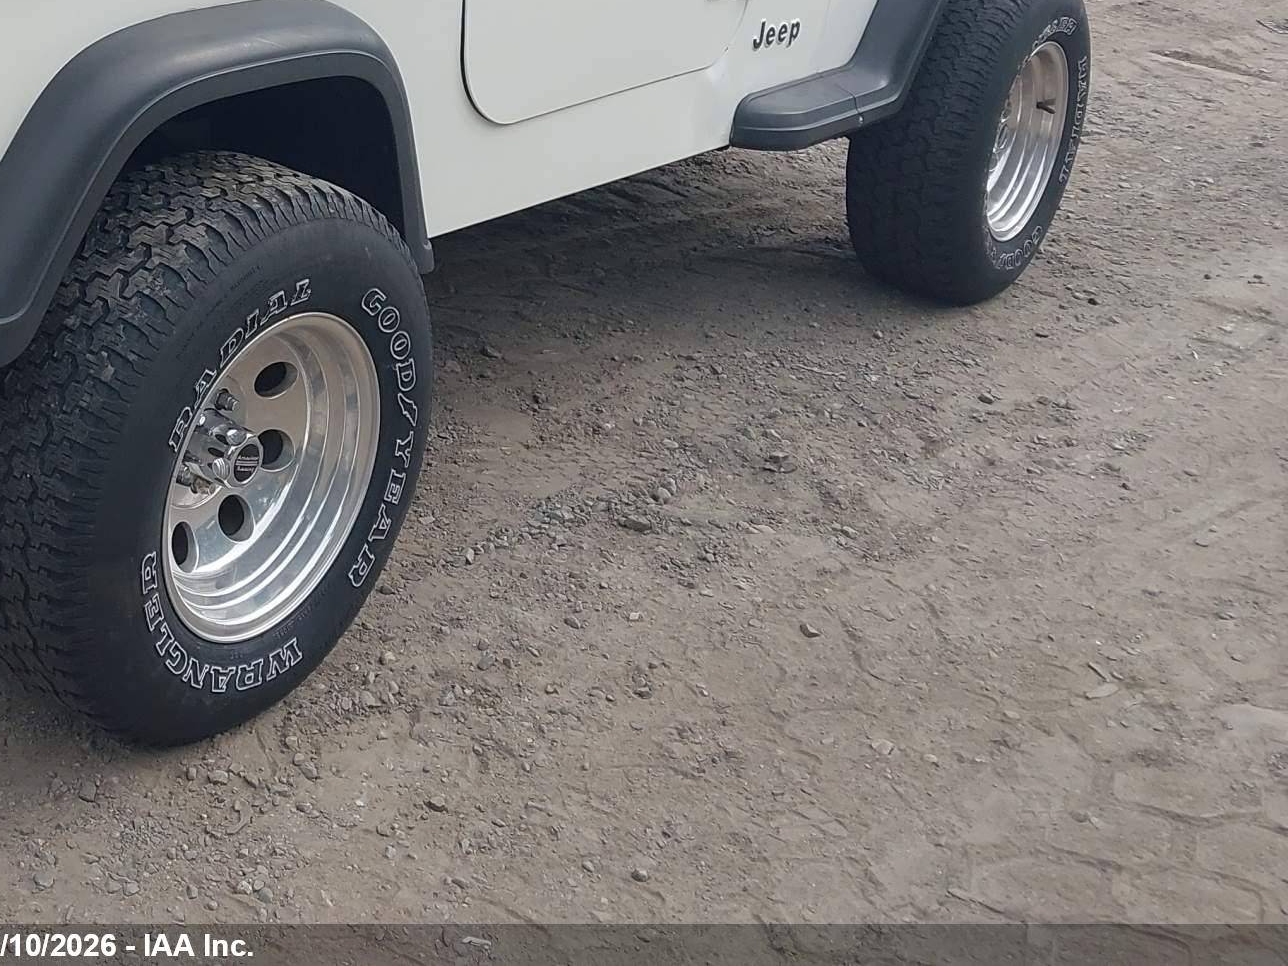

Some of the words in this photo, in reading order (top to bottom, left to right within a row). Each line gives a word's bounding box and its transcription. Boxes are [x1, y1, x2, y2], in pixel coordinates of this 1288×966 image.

[753, 19, 801, 51] Jeep
[169, 279, 311, 452] RADIAL
[349, 288, 419, 587] GOODYEAR
[142, 551, 303, 693] WRANGLER
